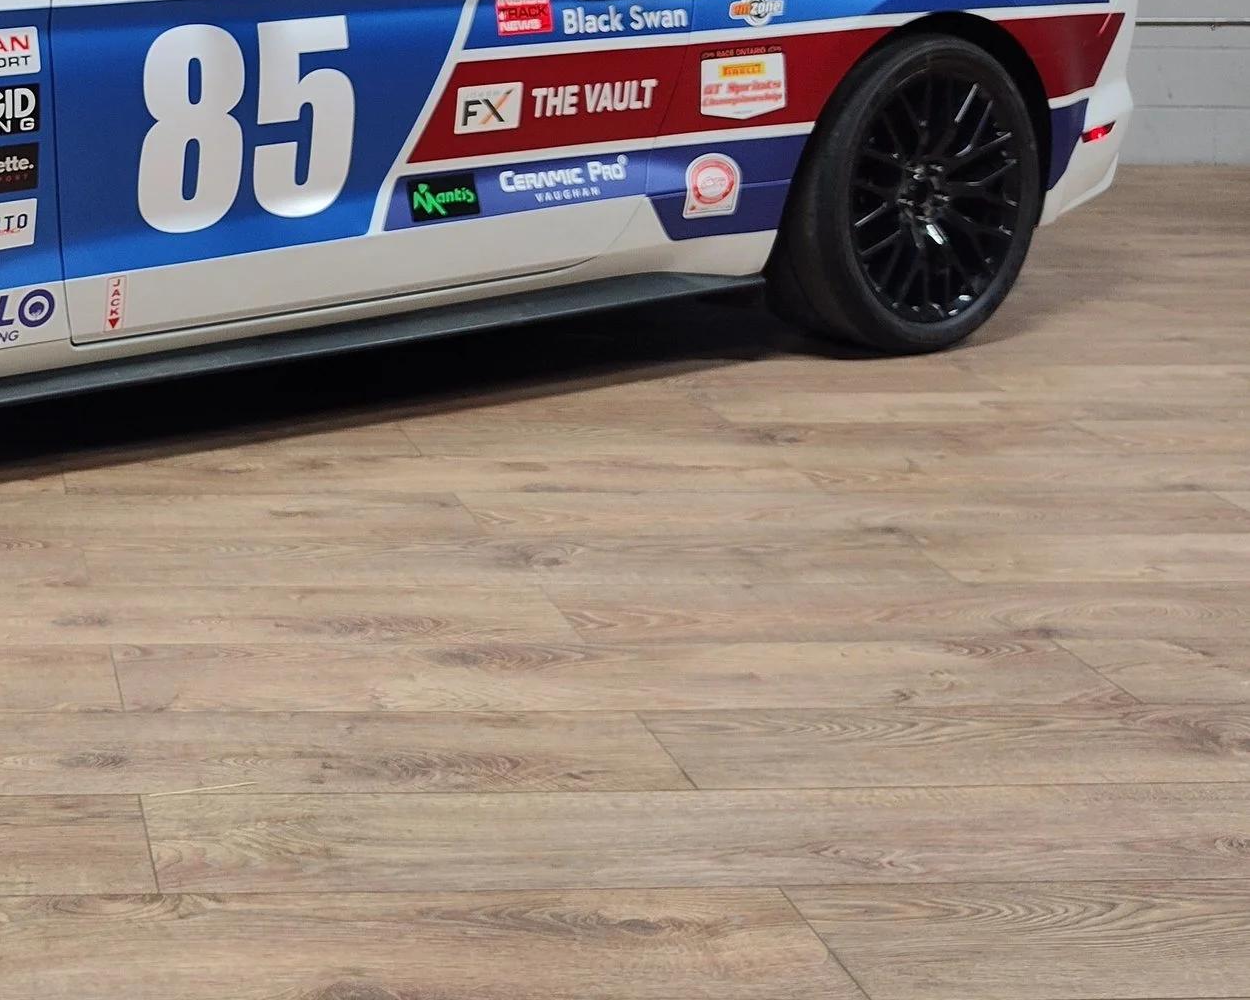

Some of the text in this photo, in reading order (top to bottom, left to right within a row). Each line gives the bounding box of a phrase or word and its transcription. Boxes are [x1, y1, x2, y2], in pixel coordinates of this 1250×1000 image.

[498, 4, 549, 21] TRACK
[499, 19, 543, 32] NEWS
[562, 4, 689, 35] Black Swan
[461, 87, 514, 127] FX
[531, 78, 659, 119] THE VAULT
[136, 14, 356, 234] 85
[413, 186, 476, 216] Mantis
[534, 186, 602, 204] VAUGHAN
[109, 278, 122, 317] JACK
